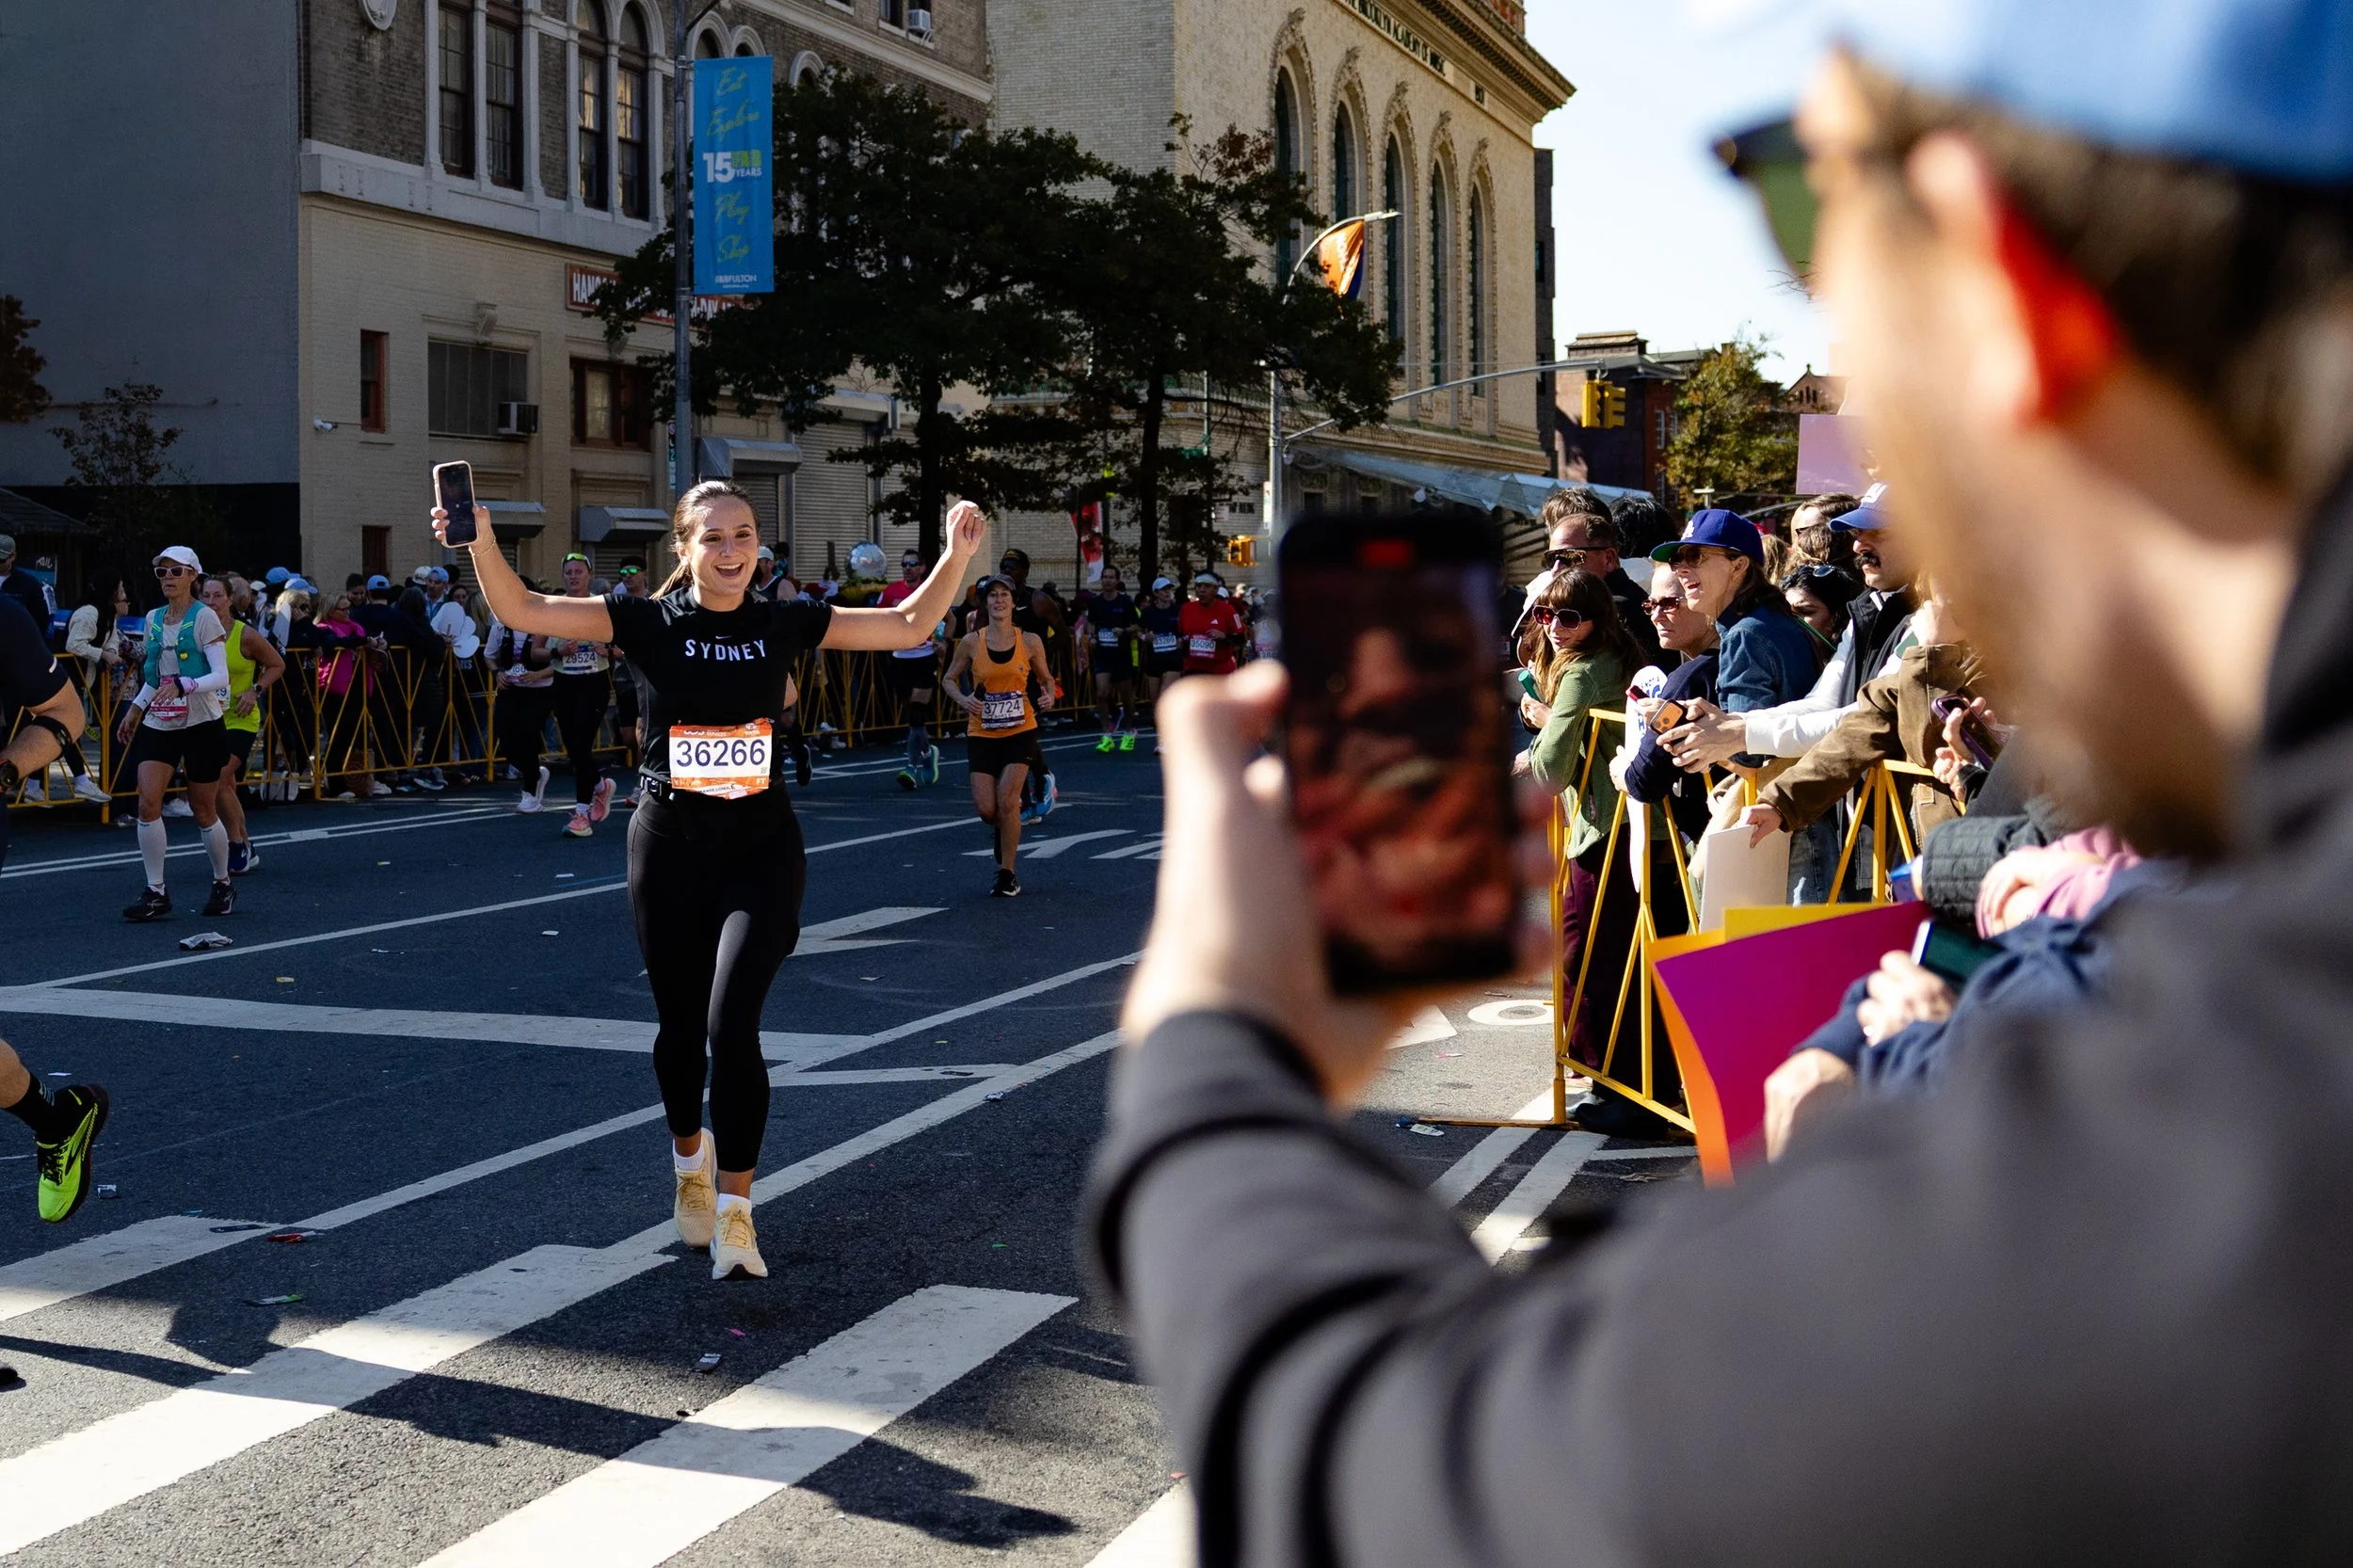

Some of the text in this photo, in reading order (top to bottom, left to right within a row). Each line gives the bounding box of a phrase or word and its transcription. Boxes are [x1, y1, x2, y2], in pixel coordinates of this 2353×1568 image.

[702, 151, 735, 183] 15
[734, 167, 761, 178] YEARS
[565, 651, 595, 664] 29524
[685, 639, 765, 661] SYDNEY
[984, 700, 1020, 714] 37724
[677, 739, 765, 767] 36266
